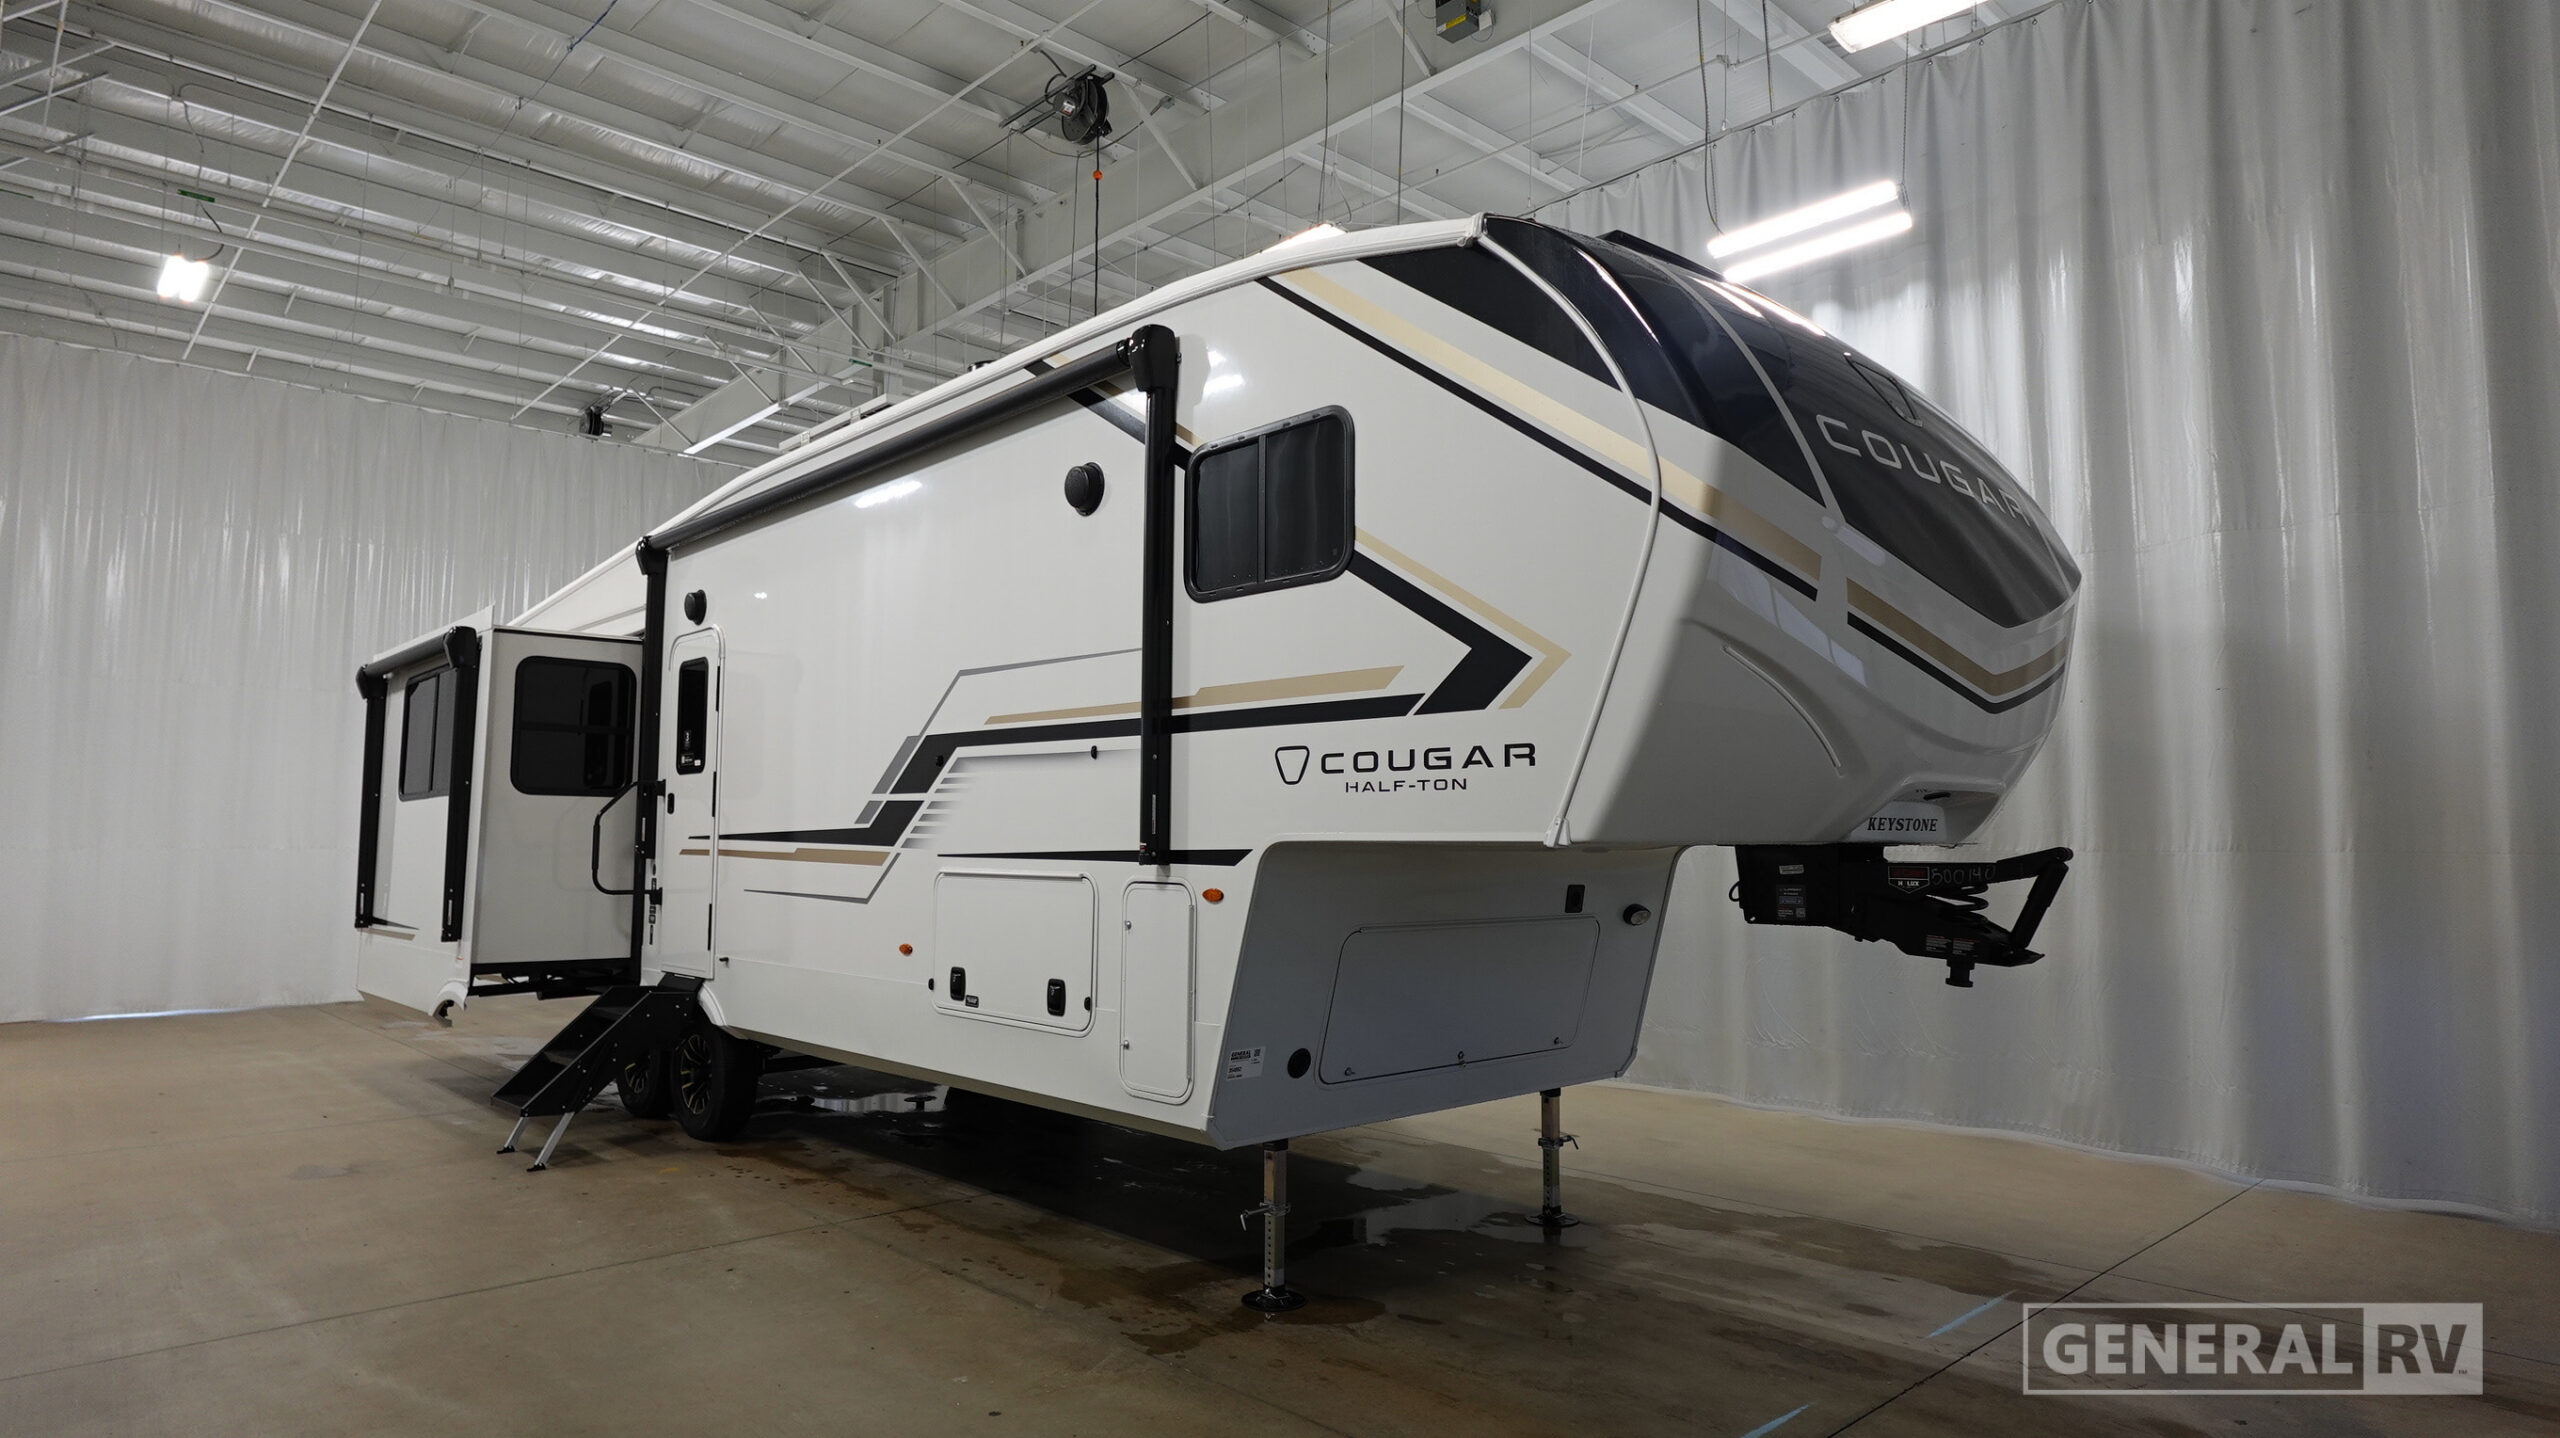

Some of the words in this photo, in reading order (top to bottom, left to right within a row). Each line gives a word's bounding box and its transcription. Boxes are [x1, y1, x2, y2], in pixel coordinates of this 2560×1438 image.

[1816, 414, 2031, 527] COUGAR
[1321, 743, 1536, 774] COUGAR
[1345, 778, 1467, 793] HALF-TON
[1867, 817, 1938, 832] KEYSTONE
